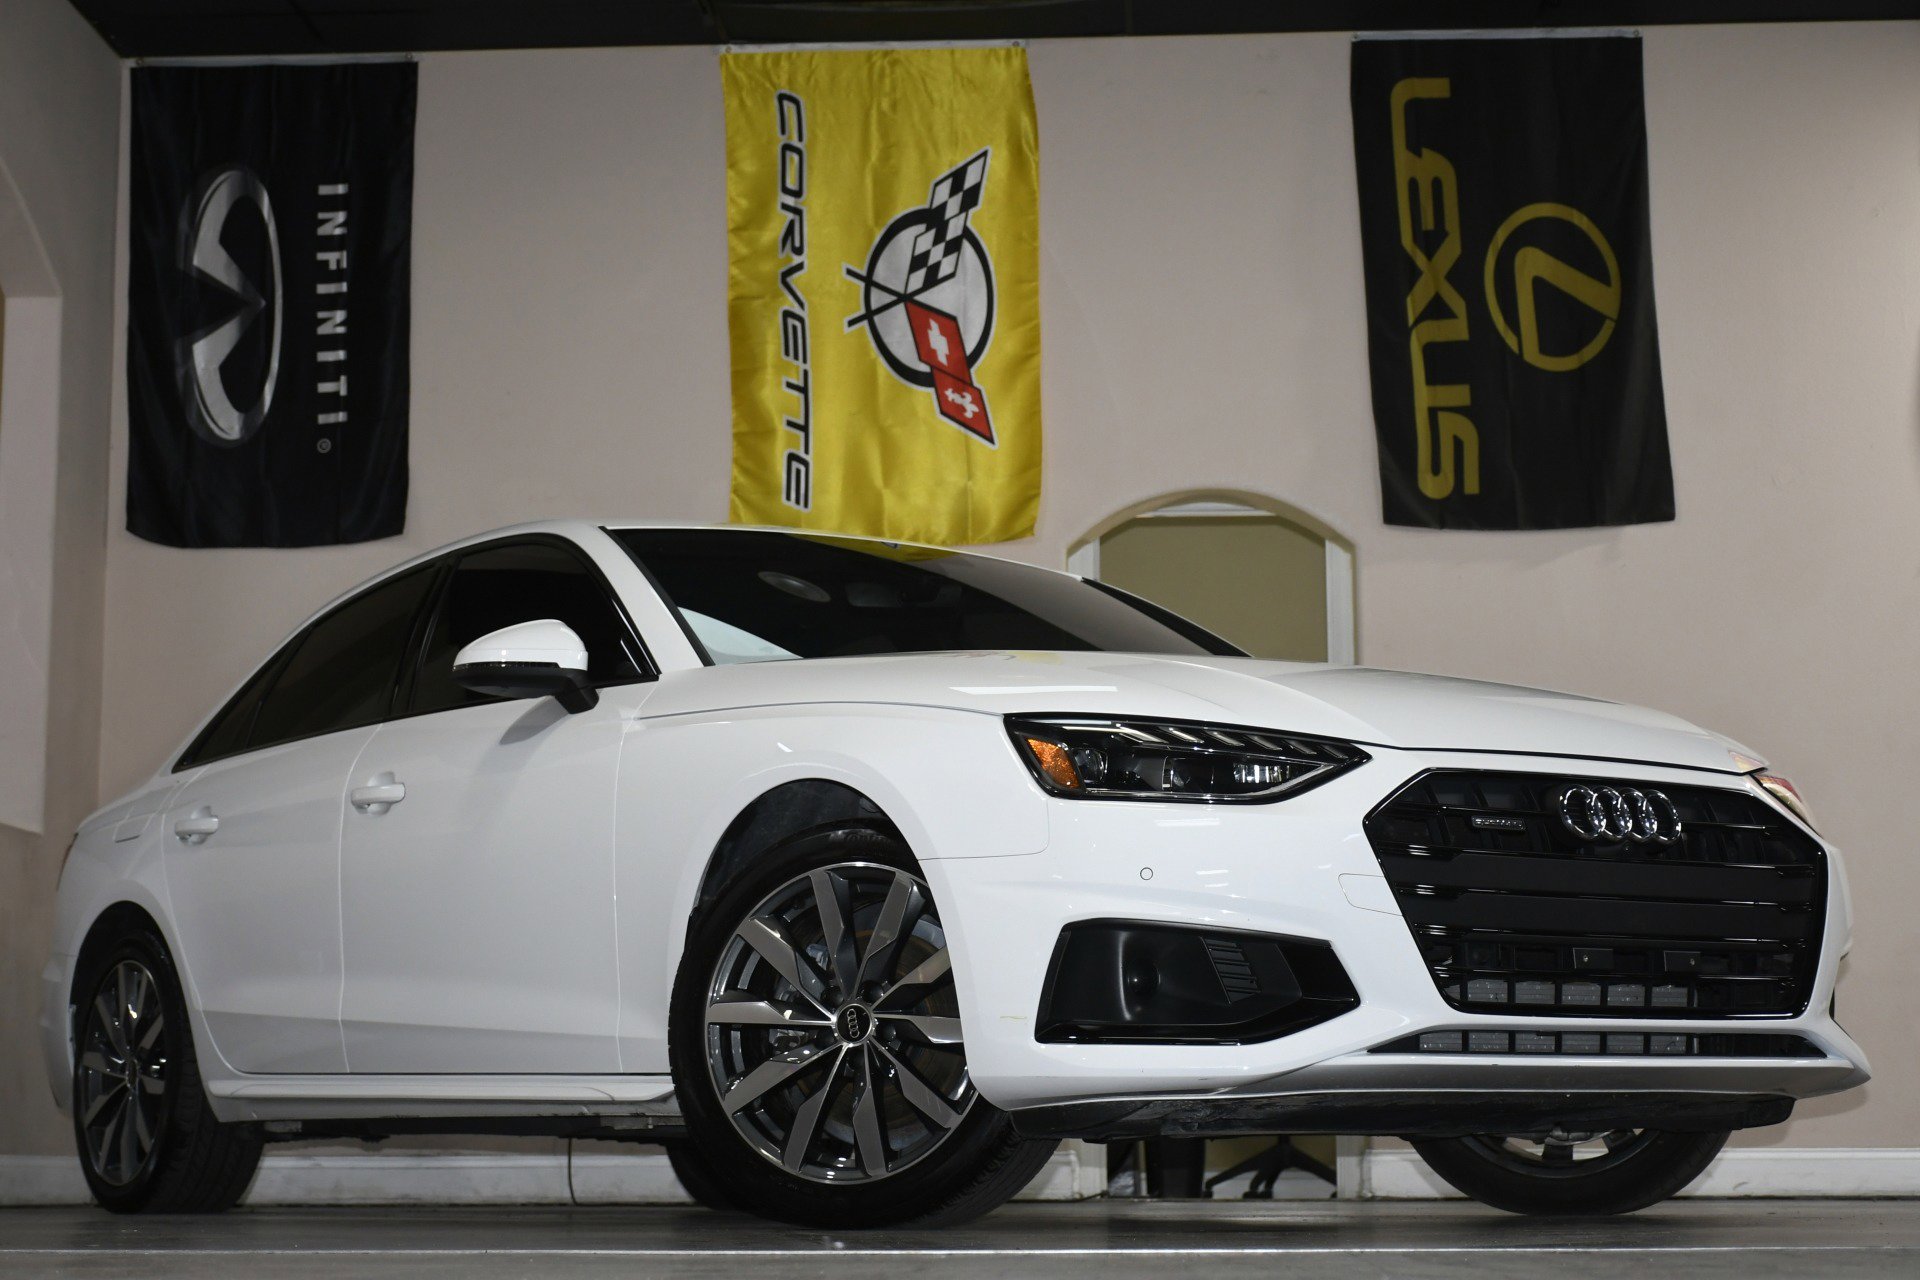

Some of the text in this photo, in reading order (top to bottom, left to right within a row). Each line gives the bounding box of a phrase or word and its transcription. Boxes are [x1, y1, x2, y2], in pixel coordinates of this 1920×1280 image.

[316, 183, 348, 424] INFINITI
[775, 88, 813, 512] CORVETTE
[1390, 77, 1480, 499] LEXUS
